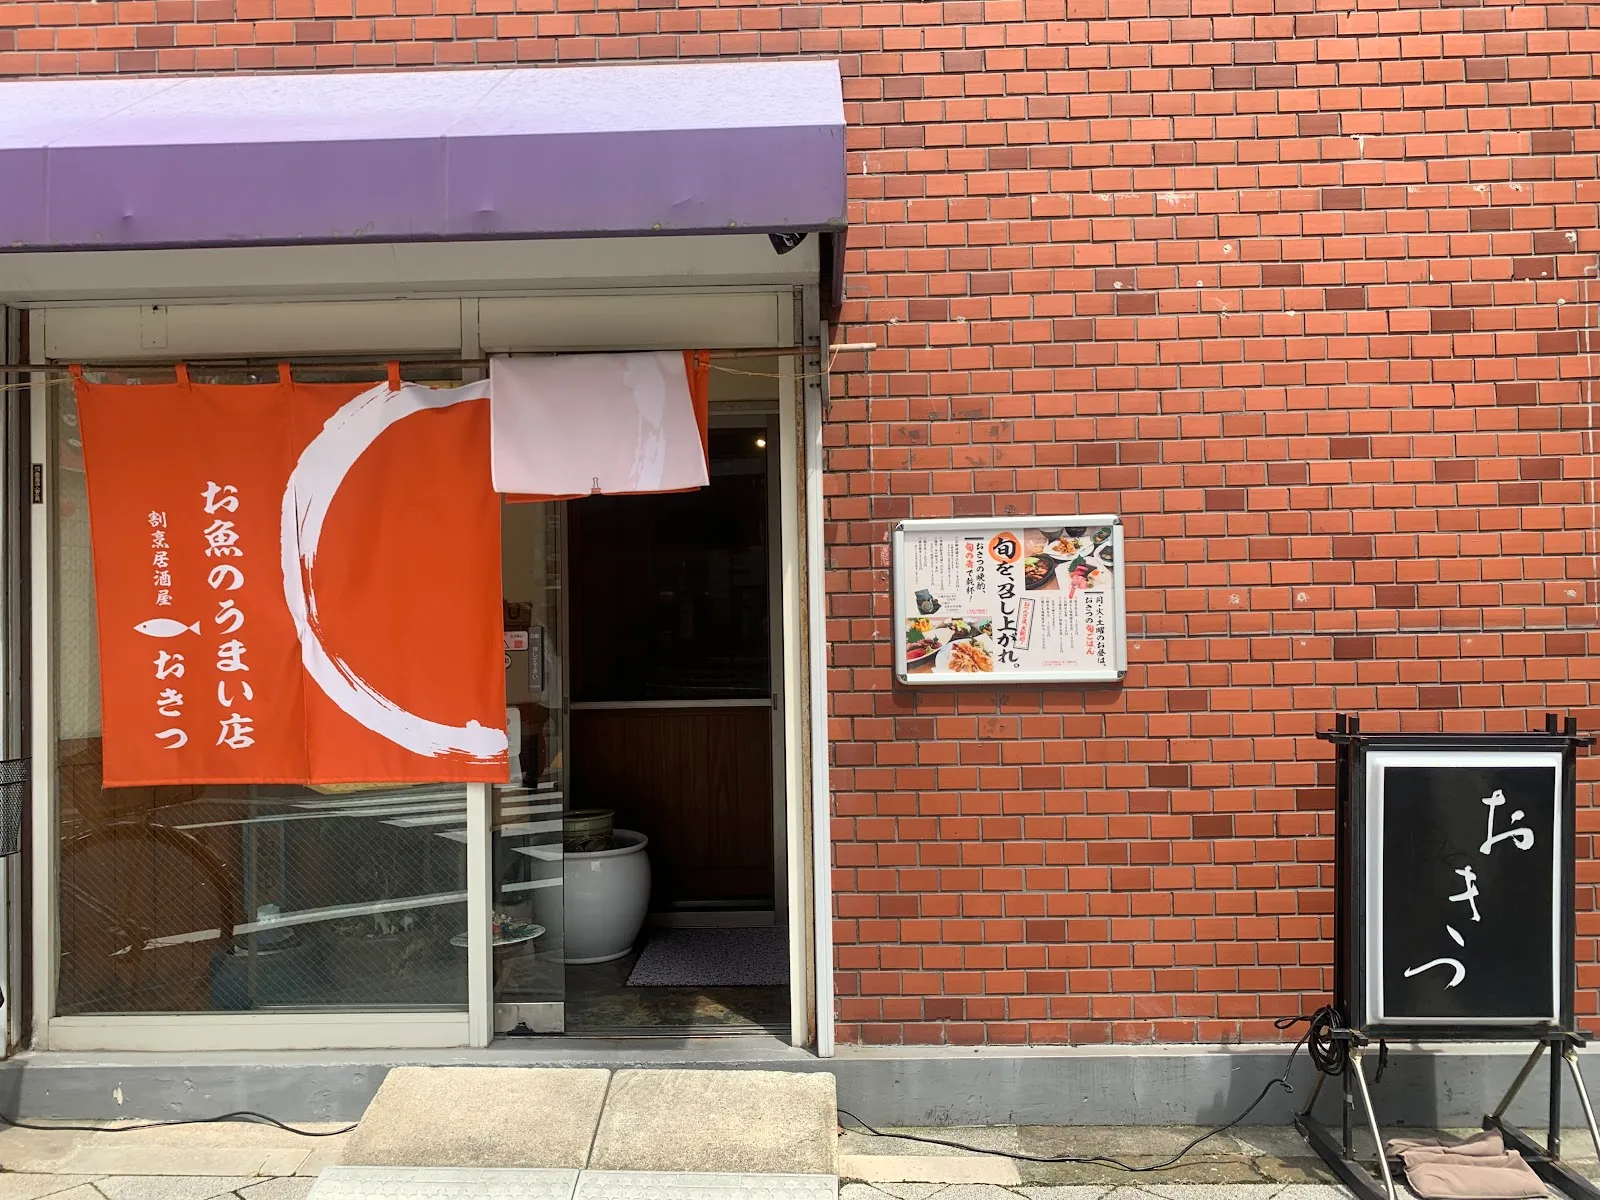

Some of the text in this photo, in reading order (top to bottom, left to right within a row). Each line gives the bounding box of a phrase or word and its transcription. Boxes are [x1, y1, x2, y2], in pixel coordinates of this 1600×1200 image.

[148, 510, 173, 607] 割烹居酒屋
[200, 481, 256, 750] お魚のうまい店
[992, 537, 1020, 668] 旬を、召し上がれ。
[153, 650, 188, 749] おきつ
[1403, 789, 1534, 990] おきつ
